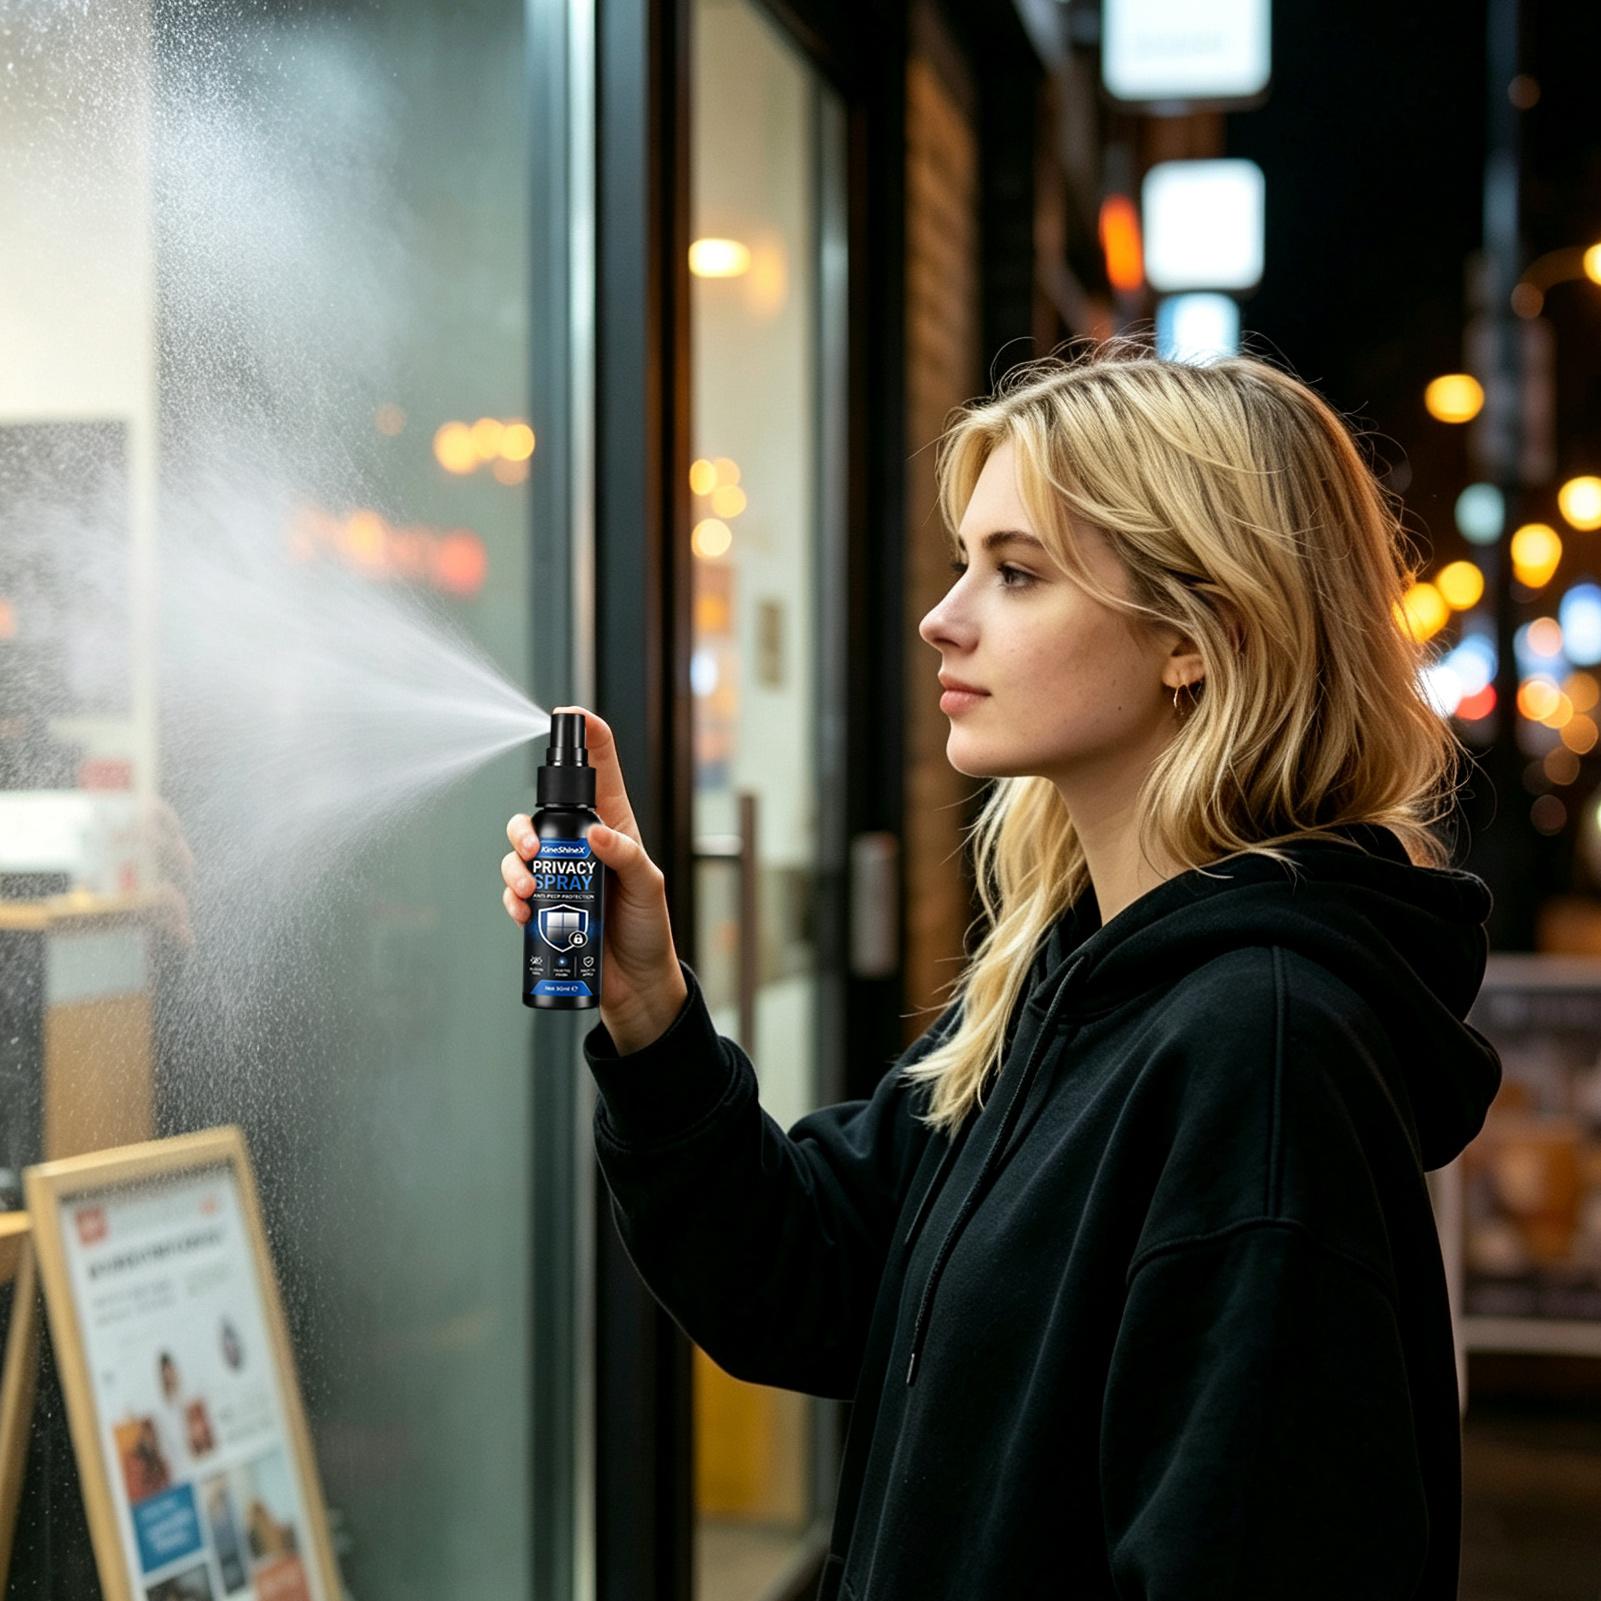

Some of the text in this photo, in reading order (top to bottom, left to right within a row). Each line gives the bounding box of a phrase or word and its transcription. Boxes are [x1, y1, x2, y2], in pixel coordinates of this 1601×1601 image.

[541, 846, 586, 854] KineShineX
[533, 861, 596, 875] PRIVACY
[535, 874, 593, 891] SPRAY
